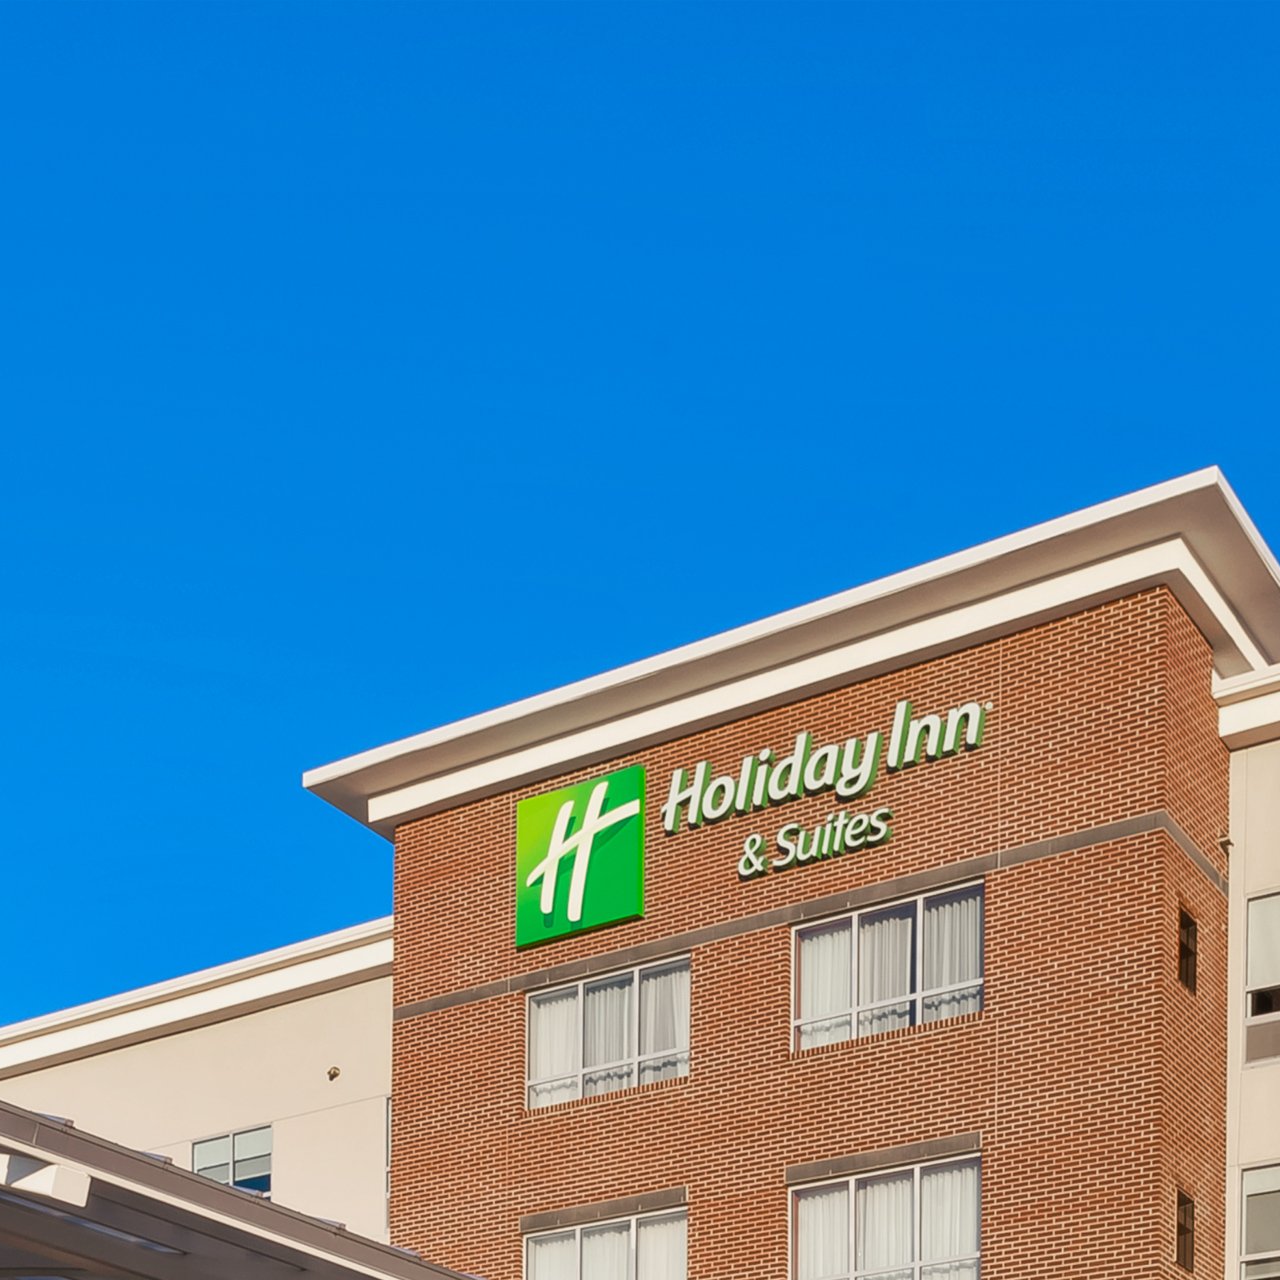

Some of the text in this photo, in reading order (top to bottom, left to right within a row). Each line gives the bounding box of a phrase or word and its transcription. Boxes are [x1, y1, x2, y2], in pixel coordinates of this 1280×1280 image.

[661, 700, 987, 835] Holiday Inn
[738, 807, 894, 880] & Suites
